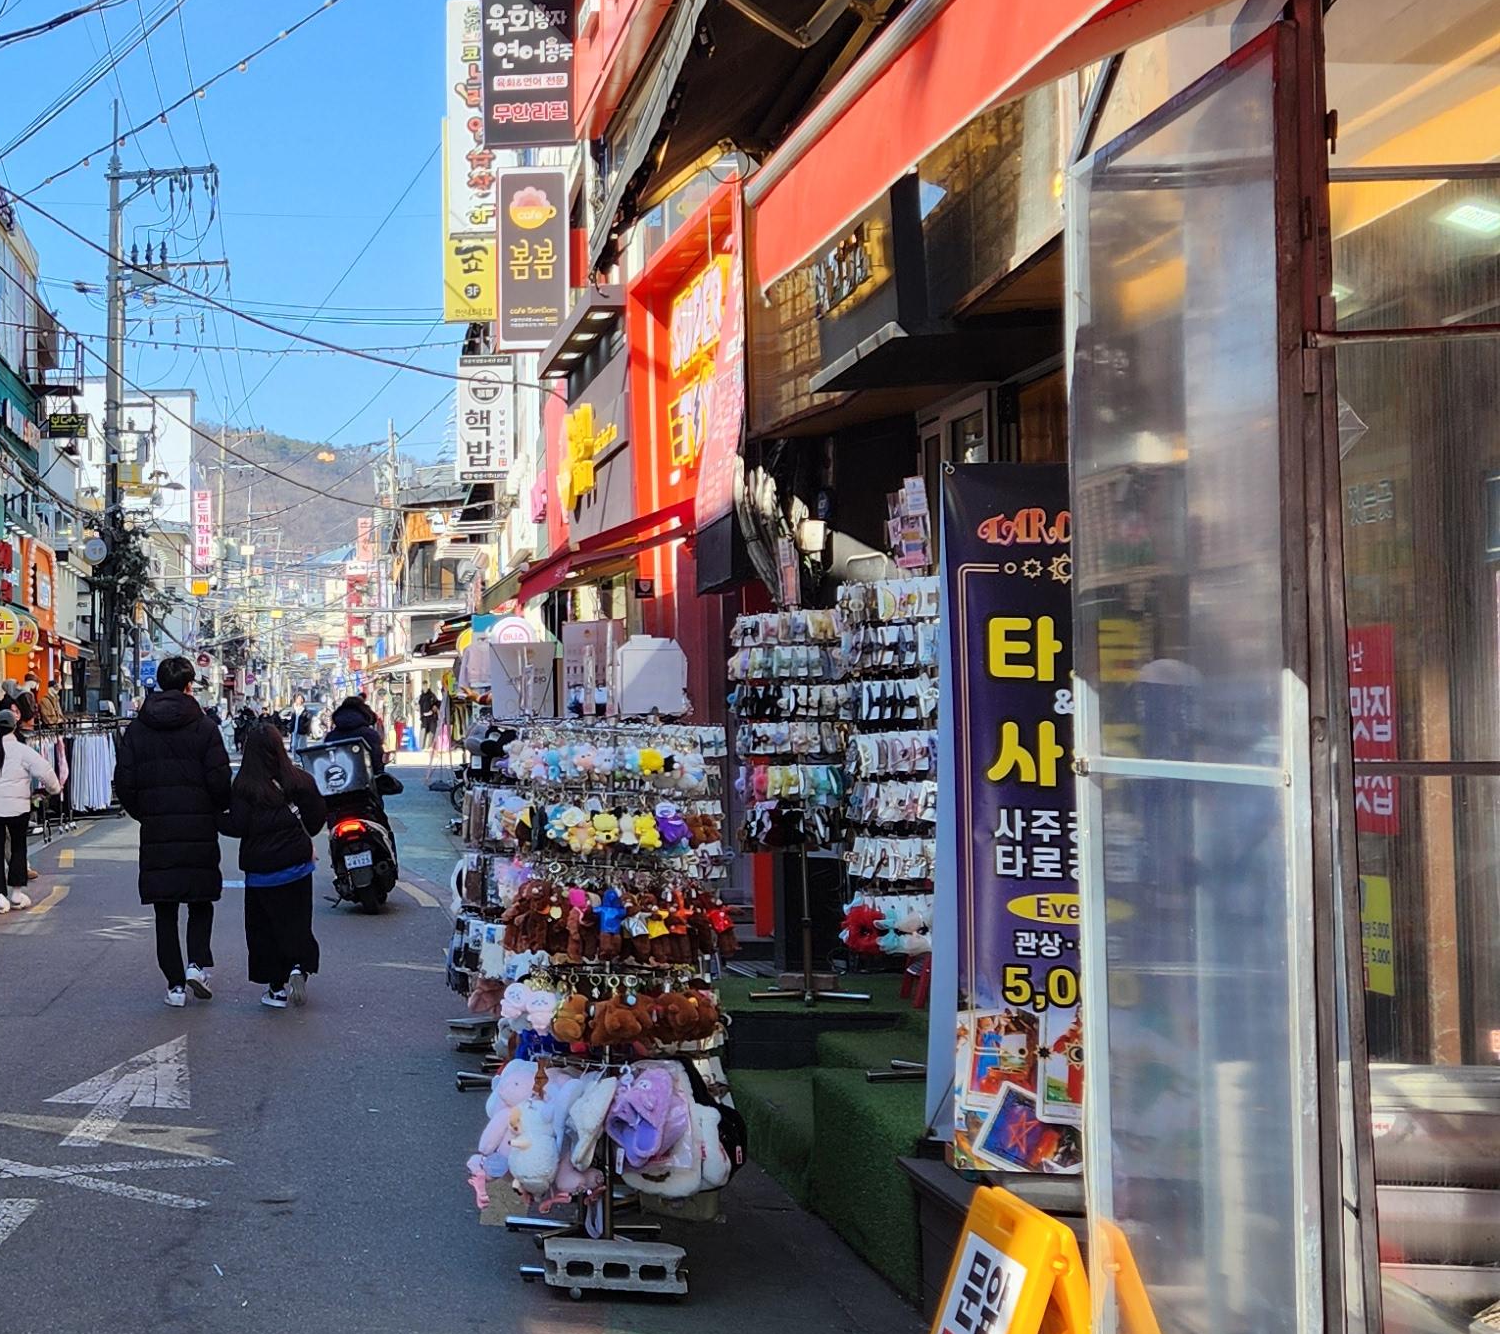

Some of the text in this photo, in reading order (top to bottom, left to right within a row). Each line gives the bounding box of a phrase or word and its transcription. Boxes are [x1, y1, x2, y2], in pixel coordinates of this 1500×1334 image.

[492, 100, 569, 123] 무한리필
[988, 615, 1063, 682] 타
[1035, 897, 1081, 920] Eve
